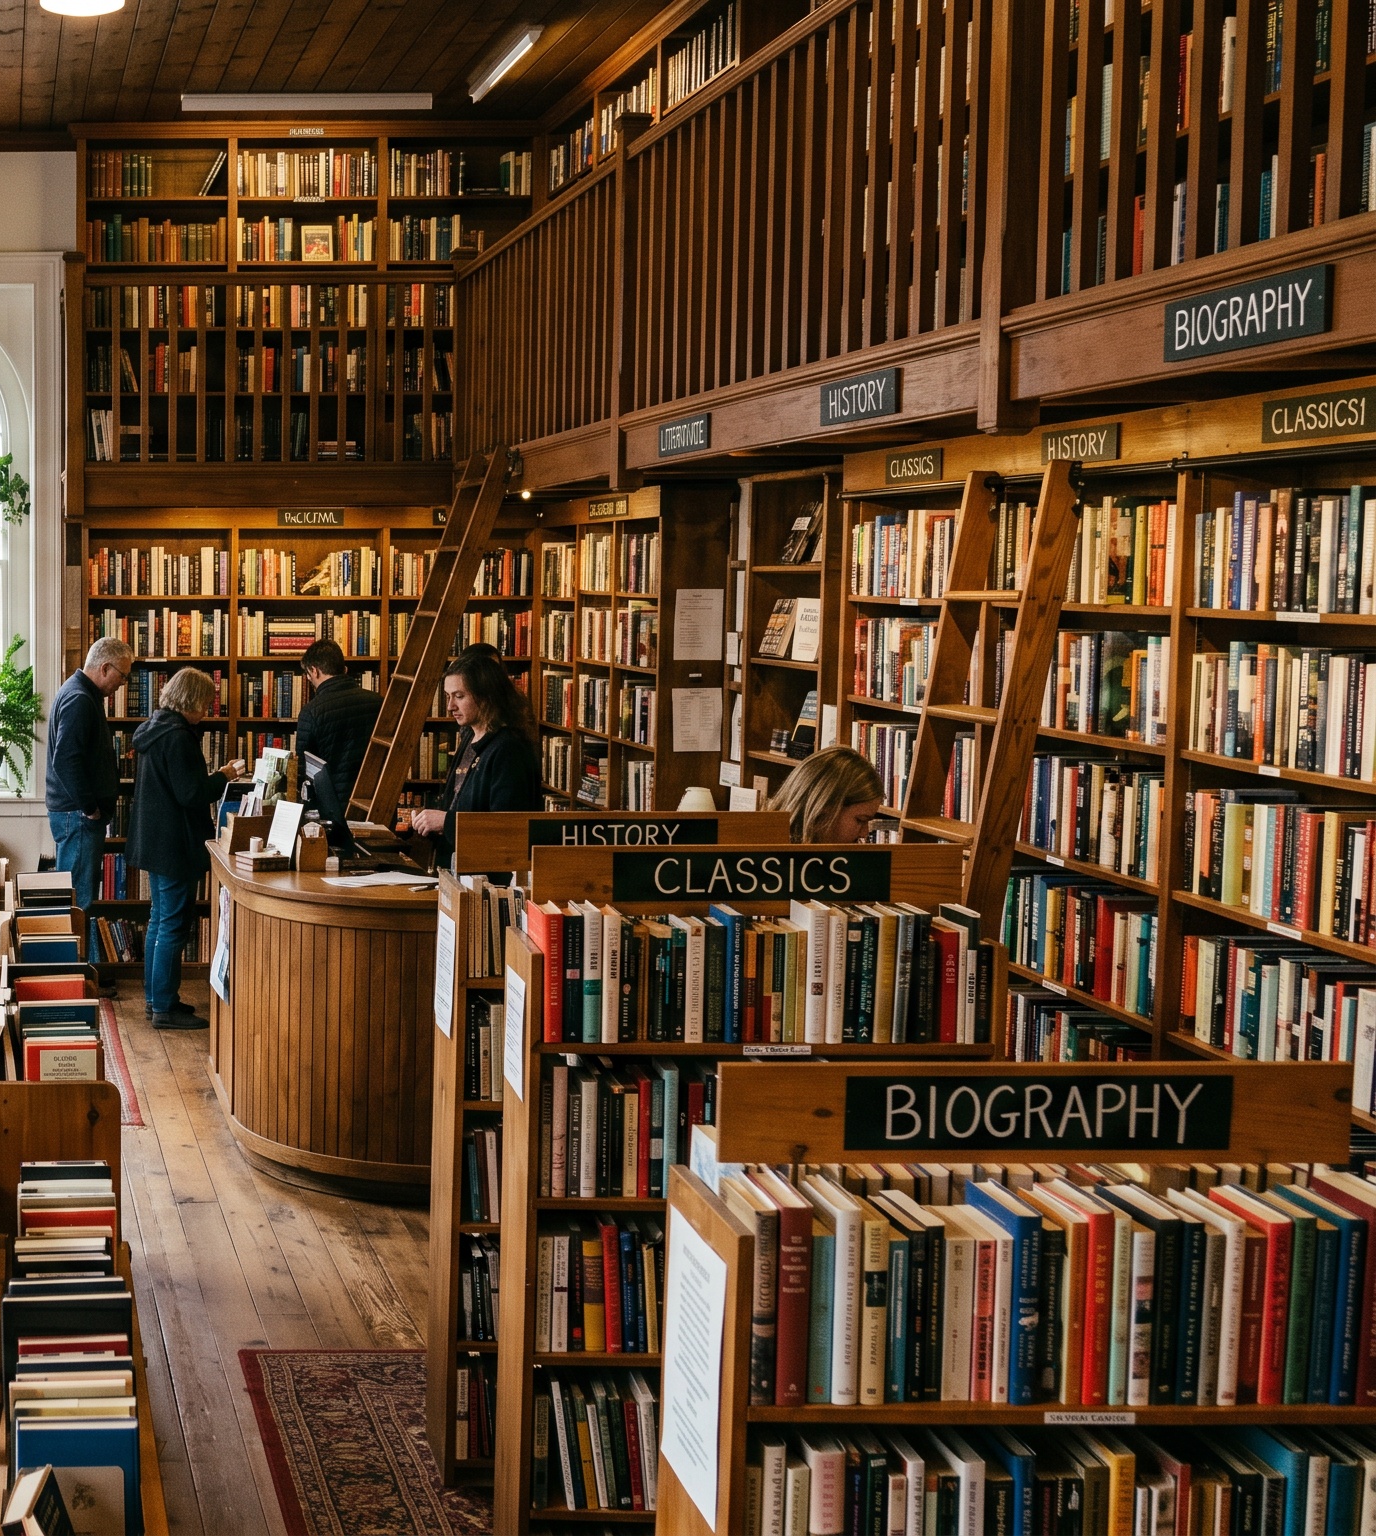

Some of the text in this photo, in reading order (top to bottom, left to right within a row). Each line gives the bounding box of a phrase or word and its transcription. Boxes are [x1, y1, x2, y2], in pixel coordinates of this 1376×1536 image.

[1175, 278, 1313, 351] BIOGRAPHY
[829, 377, 887, 419] HISTORY
[1047, 430, 1108, 460] HISTORY
[890, 455, 934, 478] CLASSICS
[562, 824, 680, 846] HISTORY
[654, 857, 851, 894] CLASSICS
[885, 1083, 1204, 1145] BIOGRAPHY
